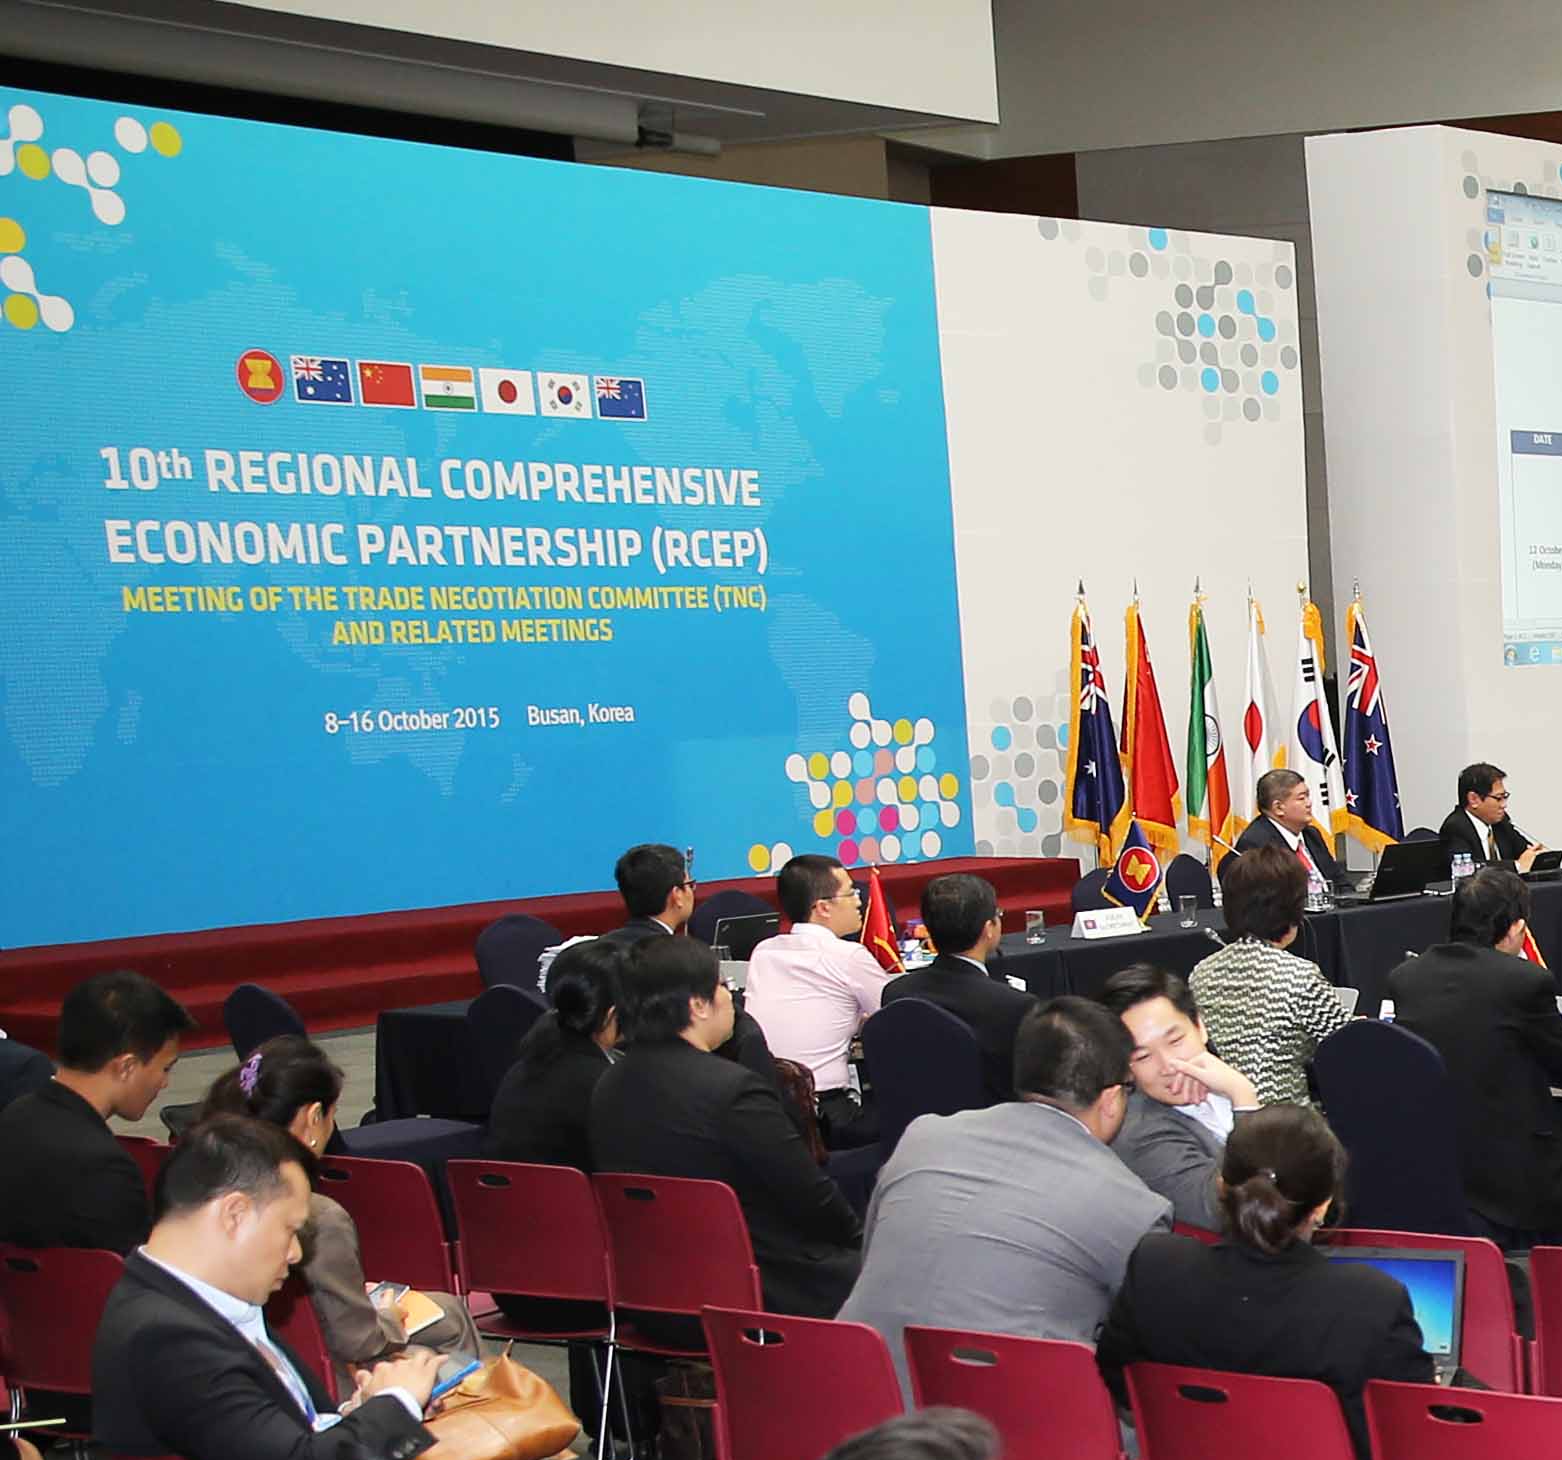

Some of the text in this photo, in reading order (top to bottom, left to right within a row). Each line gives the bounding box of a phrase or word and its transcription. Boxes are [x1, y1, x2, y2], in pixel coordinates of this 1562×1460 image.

[1533, 434, 1553, 445] DATE
[100, 446, 762, 507] 10th REGIONAL COMPREHENSIVE
[104, 519, 768, 575] ECONOMIC PARTNERSHIP (RCEP)
[122, 583, 768, 612] MEETING OF THE TRADE NEGOTIATION COMMITTEE (TNC)
[332, 618, 613, 645] AND RELATED MEETINGS
[378, 709, 449, 732] October
[453, 706, 500, 730] 2015
[527, 703, 635, 727] Busan, Korea
